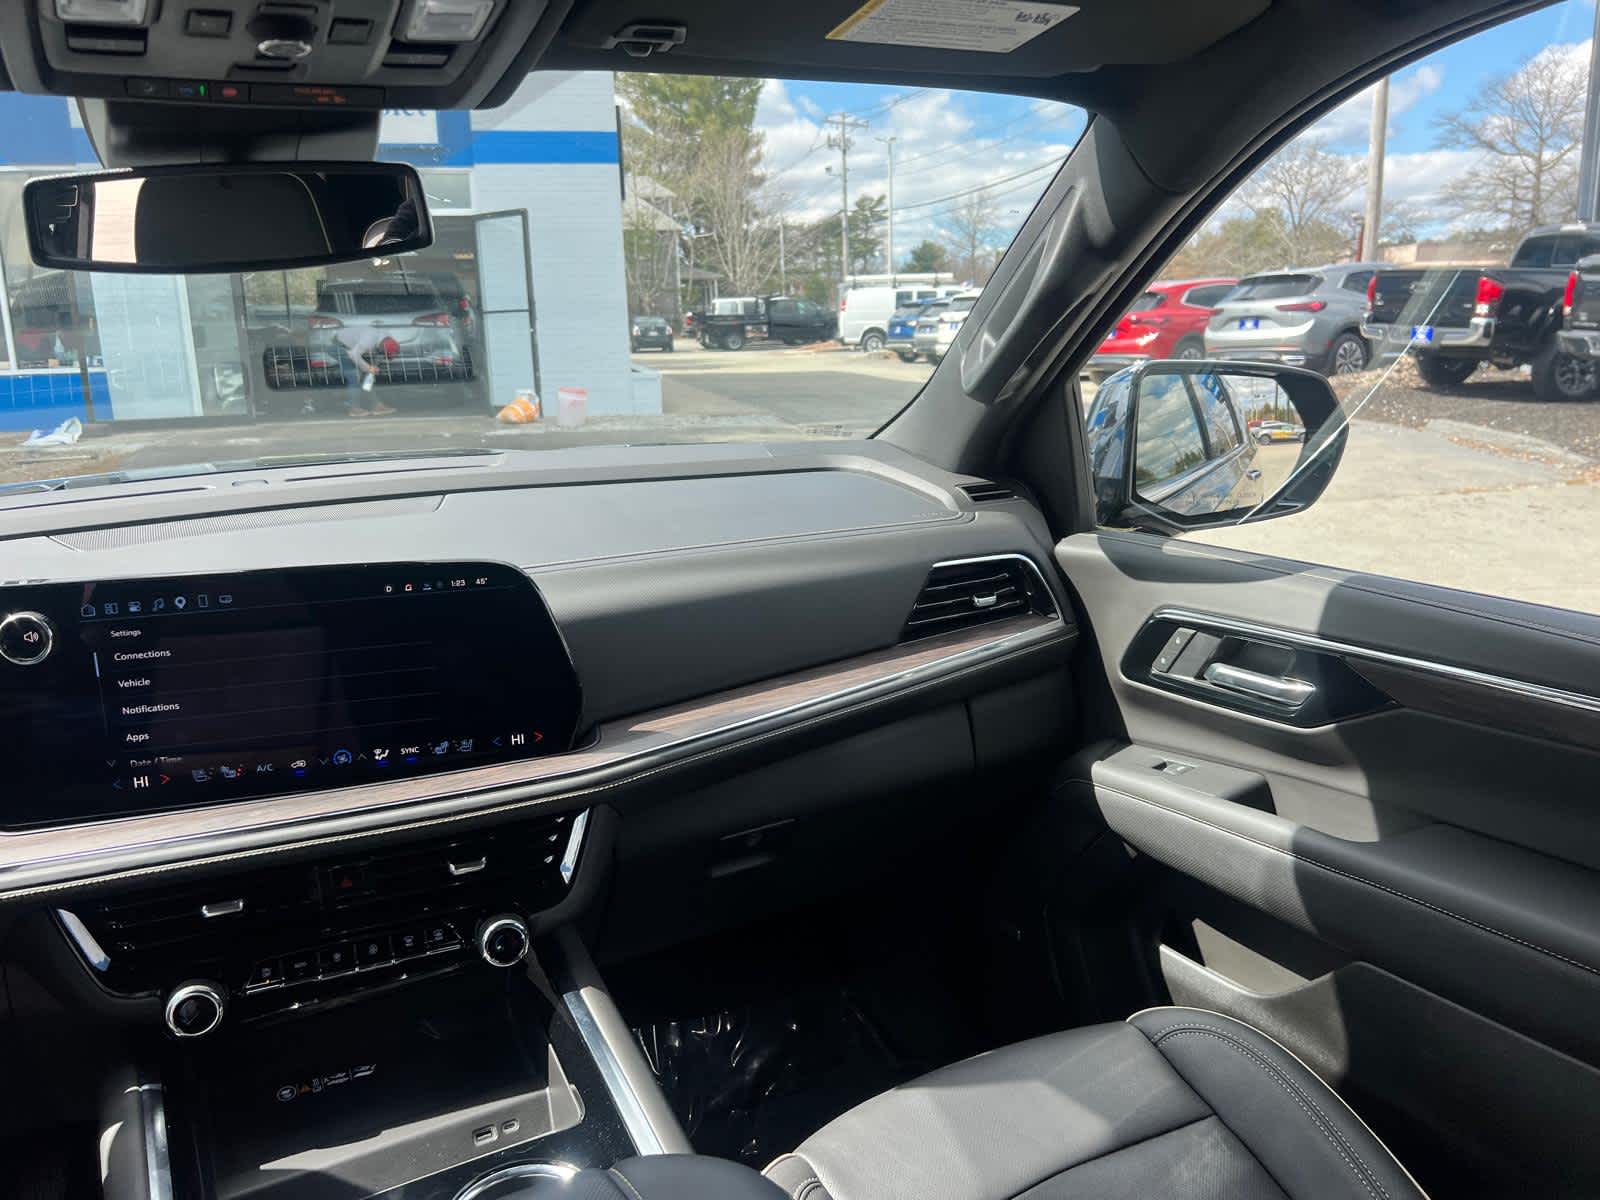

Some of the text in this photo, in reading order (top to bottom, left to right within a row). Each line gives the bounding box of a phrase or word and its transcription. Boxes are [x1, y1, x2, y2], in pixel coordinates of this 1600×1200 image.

[451, 579, 466, 587] 1:23
[114, 650, 171, 660] Connections
[118, 678, 151, 688] Vehicle
[122, 704, 180, 715] Notifications
[126, 733, 150, 743] Apps
[511, 733, 524, 746] HI
[400, 746, 420, 755] SYNC
[256, 763, 273, 772] A/C
[133, 776, 149, 788] HI
